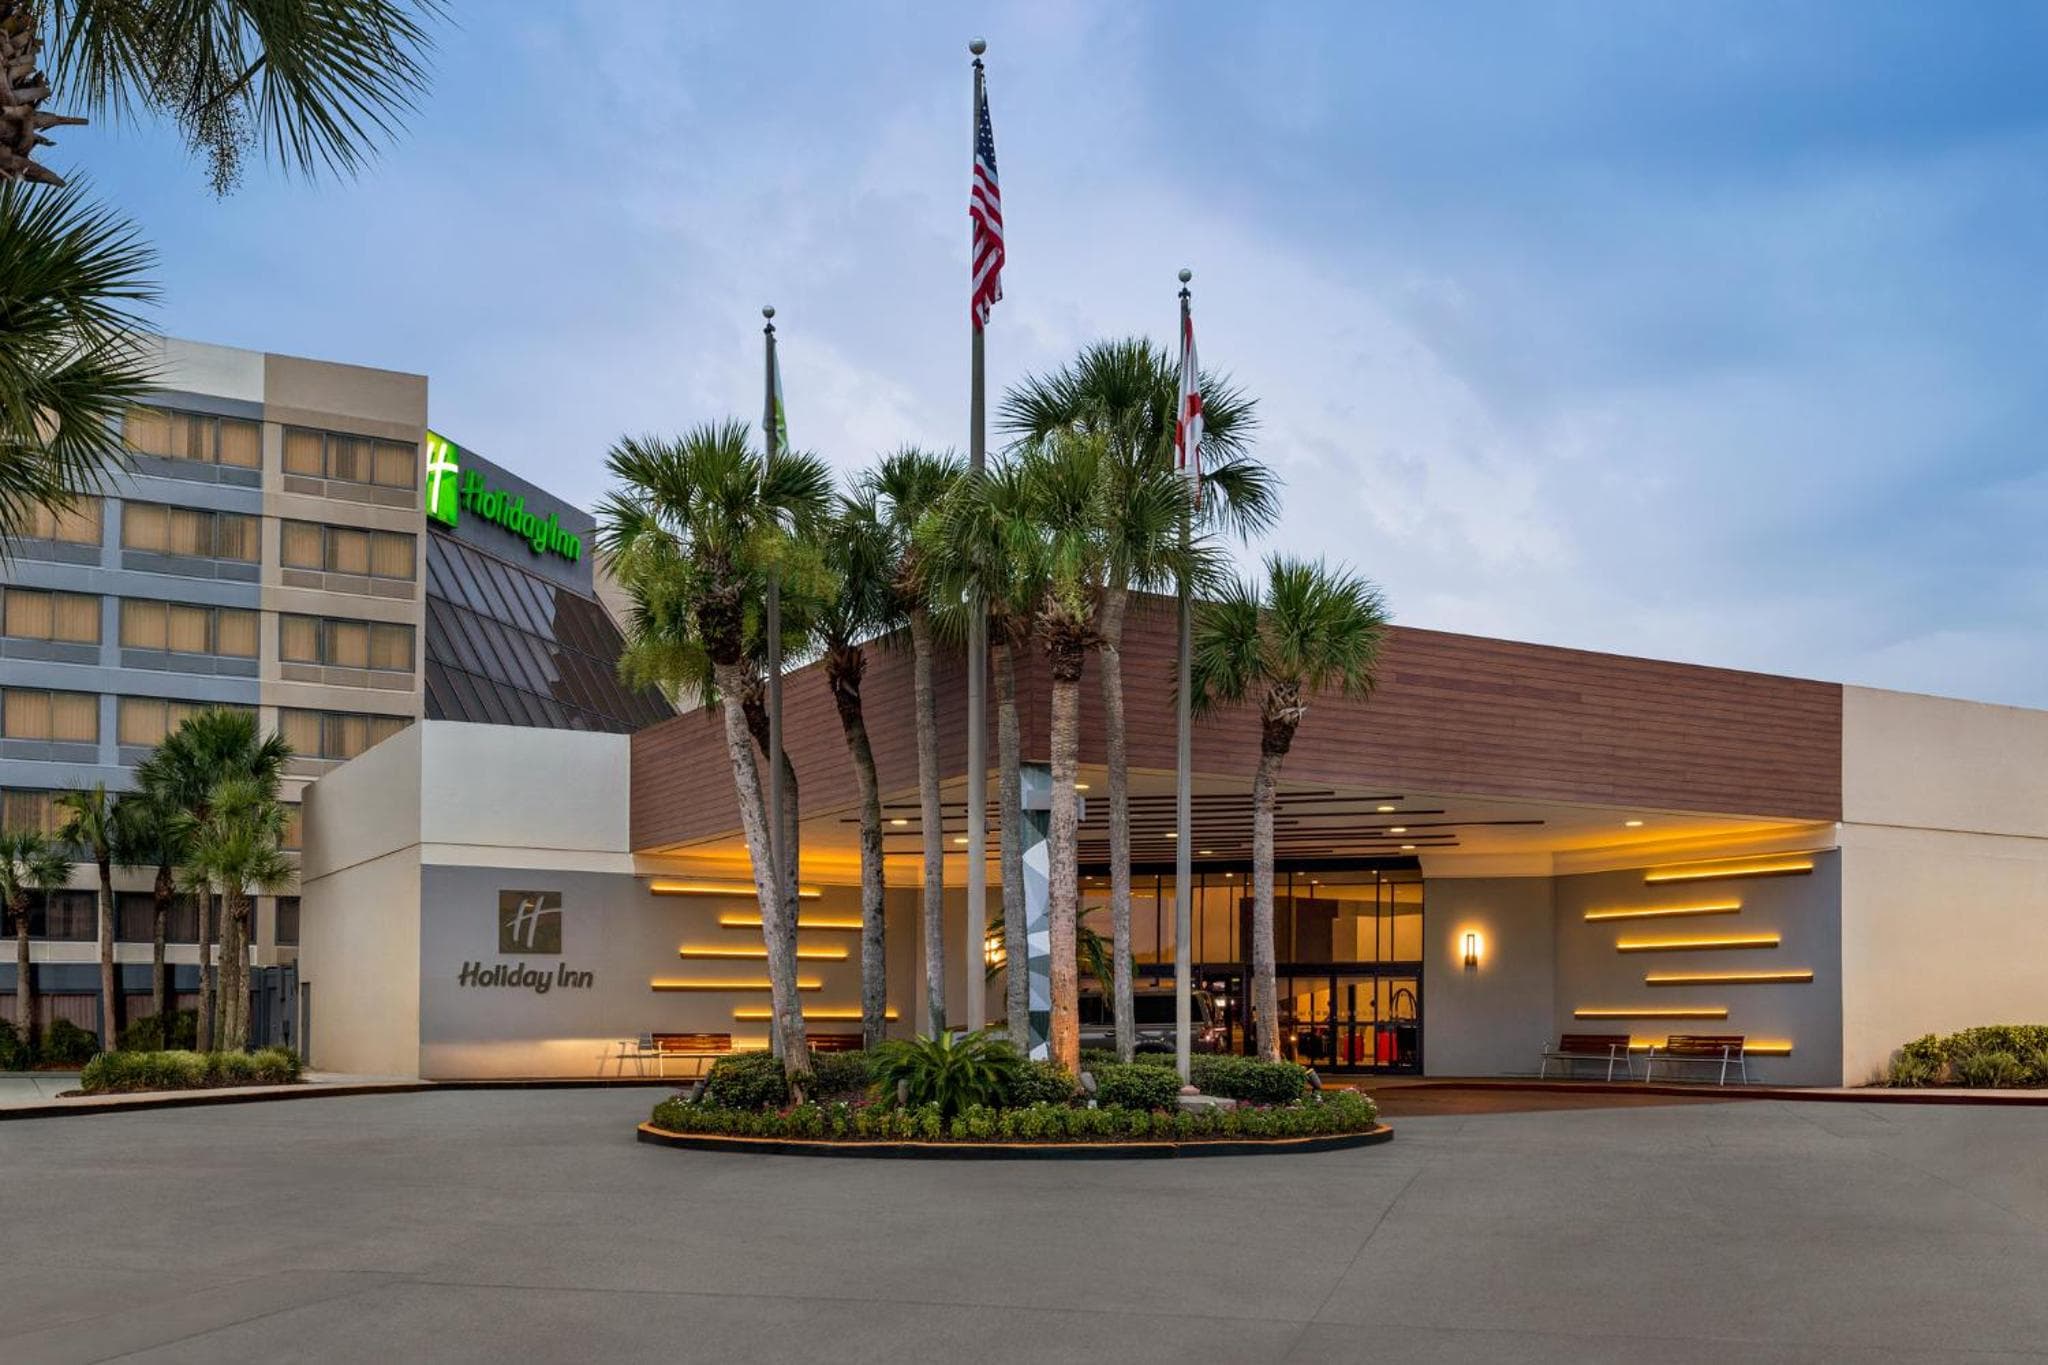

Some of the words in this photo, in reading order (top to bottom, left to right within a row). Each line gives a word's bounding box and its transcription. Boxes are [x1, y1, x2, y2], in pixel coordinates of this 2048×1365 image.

[461, 468, 548, 553] Holiday
[548, 512, 582, 561] Inn
[458, 961, 553, 994] Holiday
[557, 962, 594, 989] Inn
